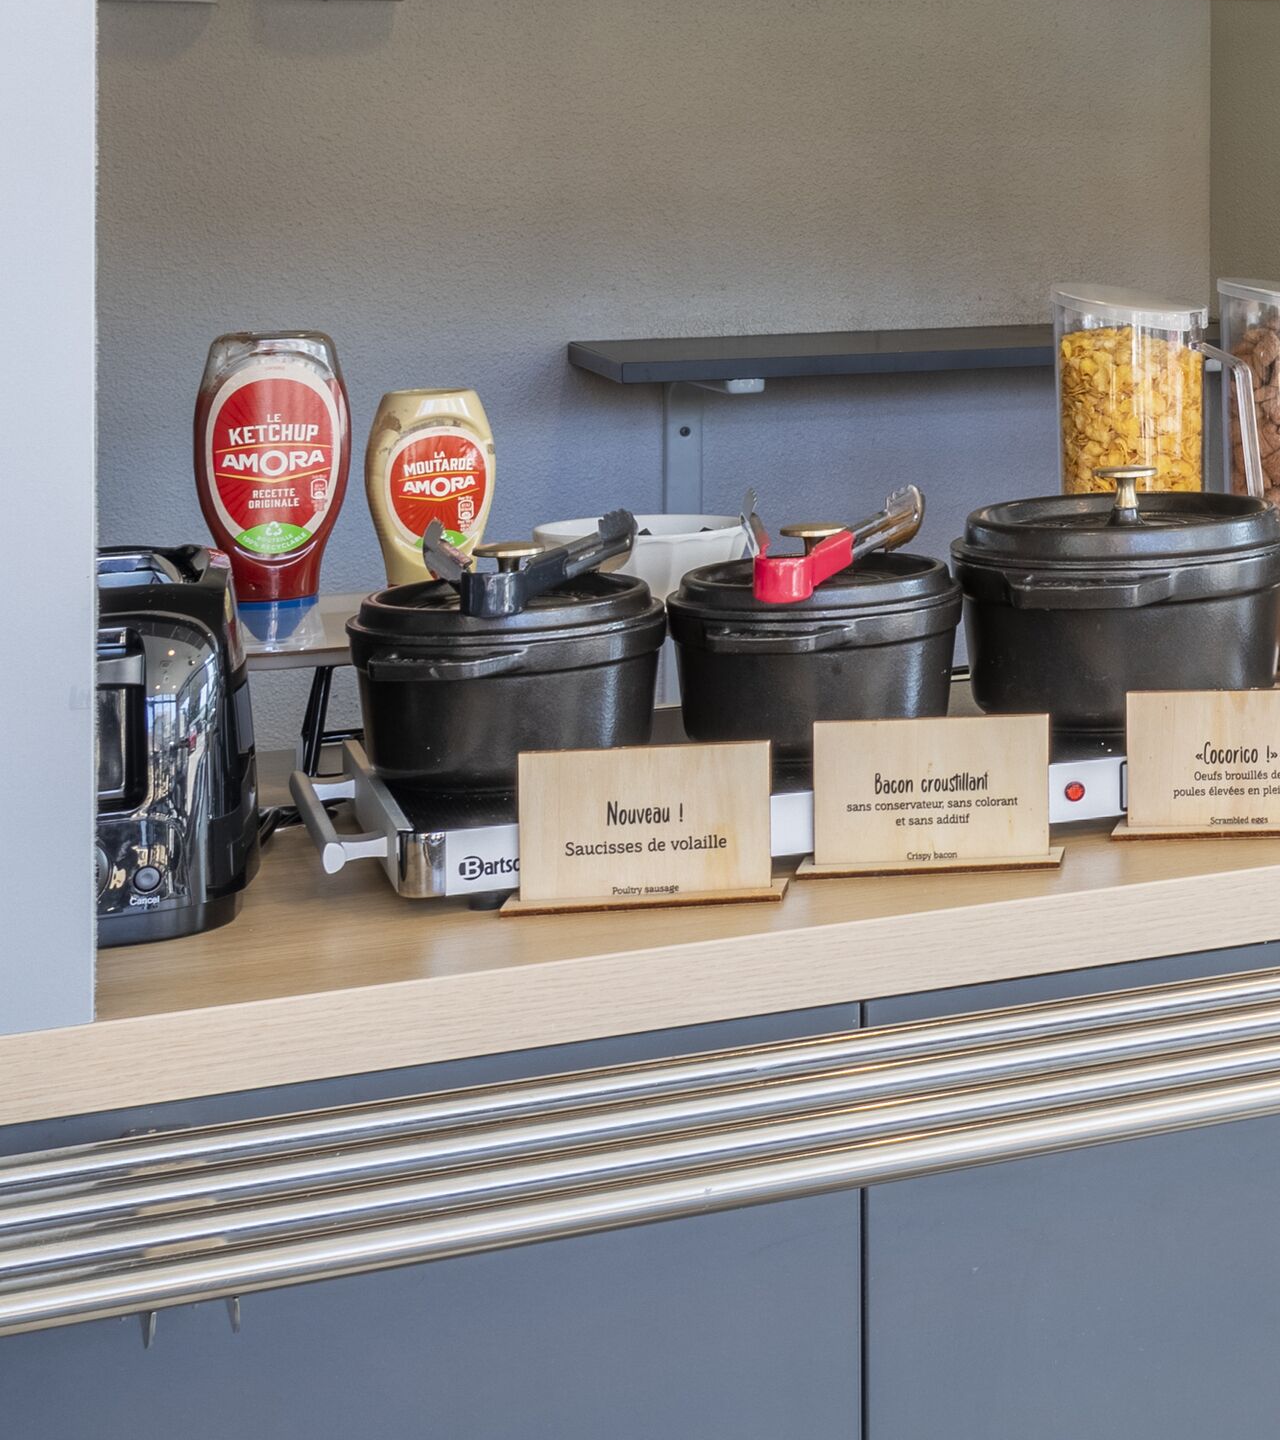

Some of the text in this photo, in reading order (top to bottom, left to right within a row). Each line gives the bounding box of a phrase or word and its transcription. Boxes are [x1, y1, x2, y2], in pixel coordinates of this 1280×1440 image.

[266, 413, 282, 423] LE
[228, 424, 319, 446] KETCHUP
[434, 450, 446, 459] LA
[221, 449, 326, 477] AMORA
[403, 458, 474, 477] MOUTARDE
[402, 475, 476, 497] AMORA
[252, 488, 296, 498] RECETTE
[248, 498, 300, 509] ORIGINALE
[874, 770, 988, 795] Bacon croustillant
[1194, 770, 1223, 782] Oeufs
[1225, 770, 1268, 781] brouillés
[1173, 786, 1206, 799] poules
[1208, 785, 1245, 796] élevées
[1248, 787, 1260, 795] en
[846, 796, 1018, 812] sans conservateur, sans colorant
[606, 800, 684, 826] Nouveau !
[895, 813, 970, 826] et sans additif
[1210, 816, 1268, 825] Scrambled eggs
[564, 834, 728, 857] Saucisses de volaille
[906, 850, 958, 861] Crispy bacon
[458, 855, 521, 881] Bartsc
[612, 884, 680, 896] Poultry sausage
[129, 894, 160, 906] Cancel
